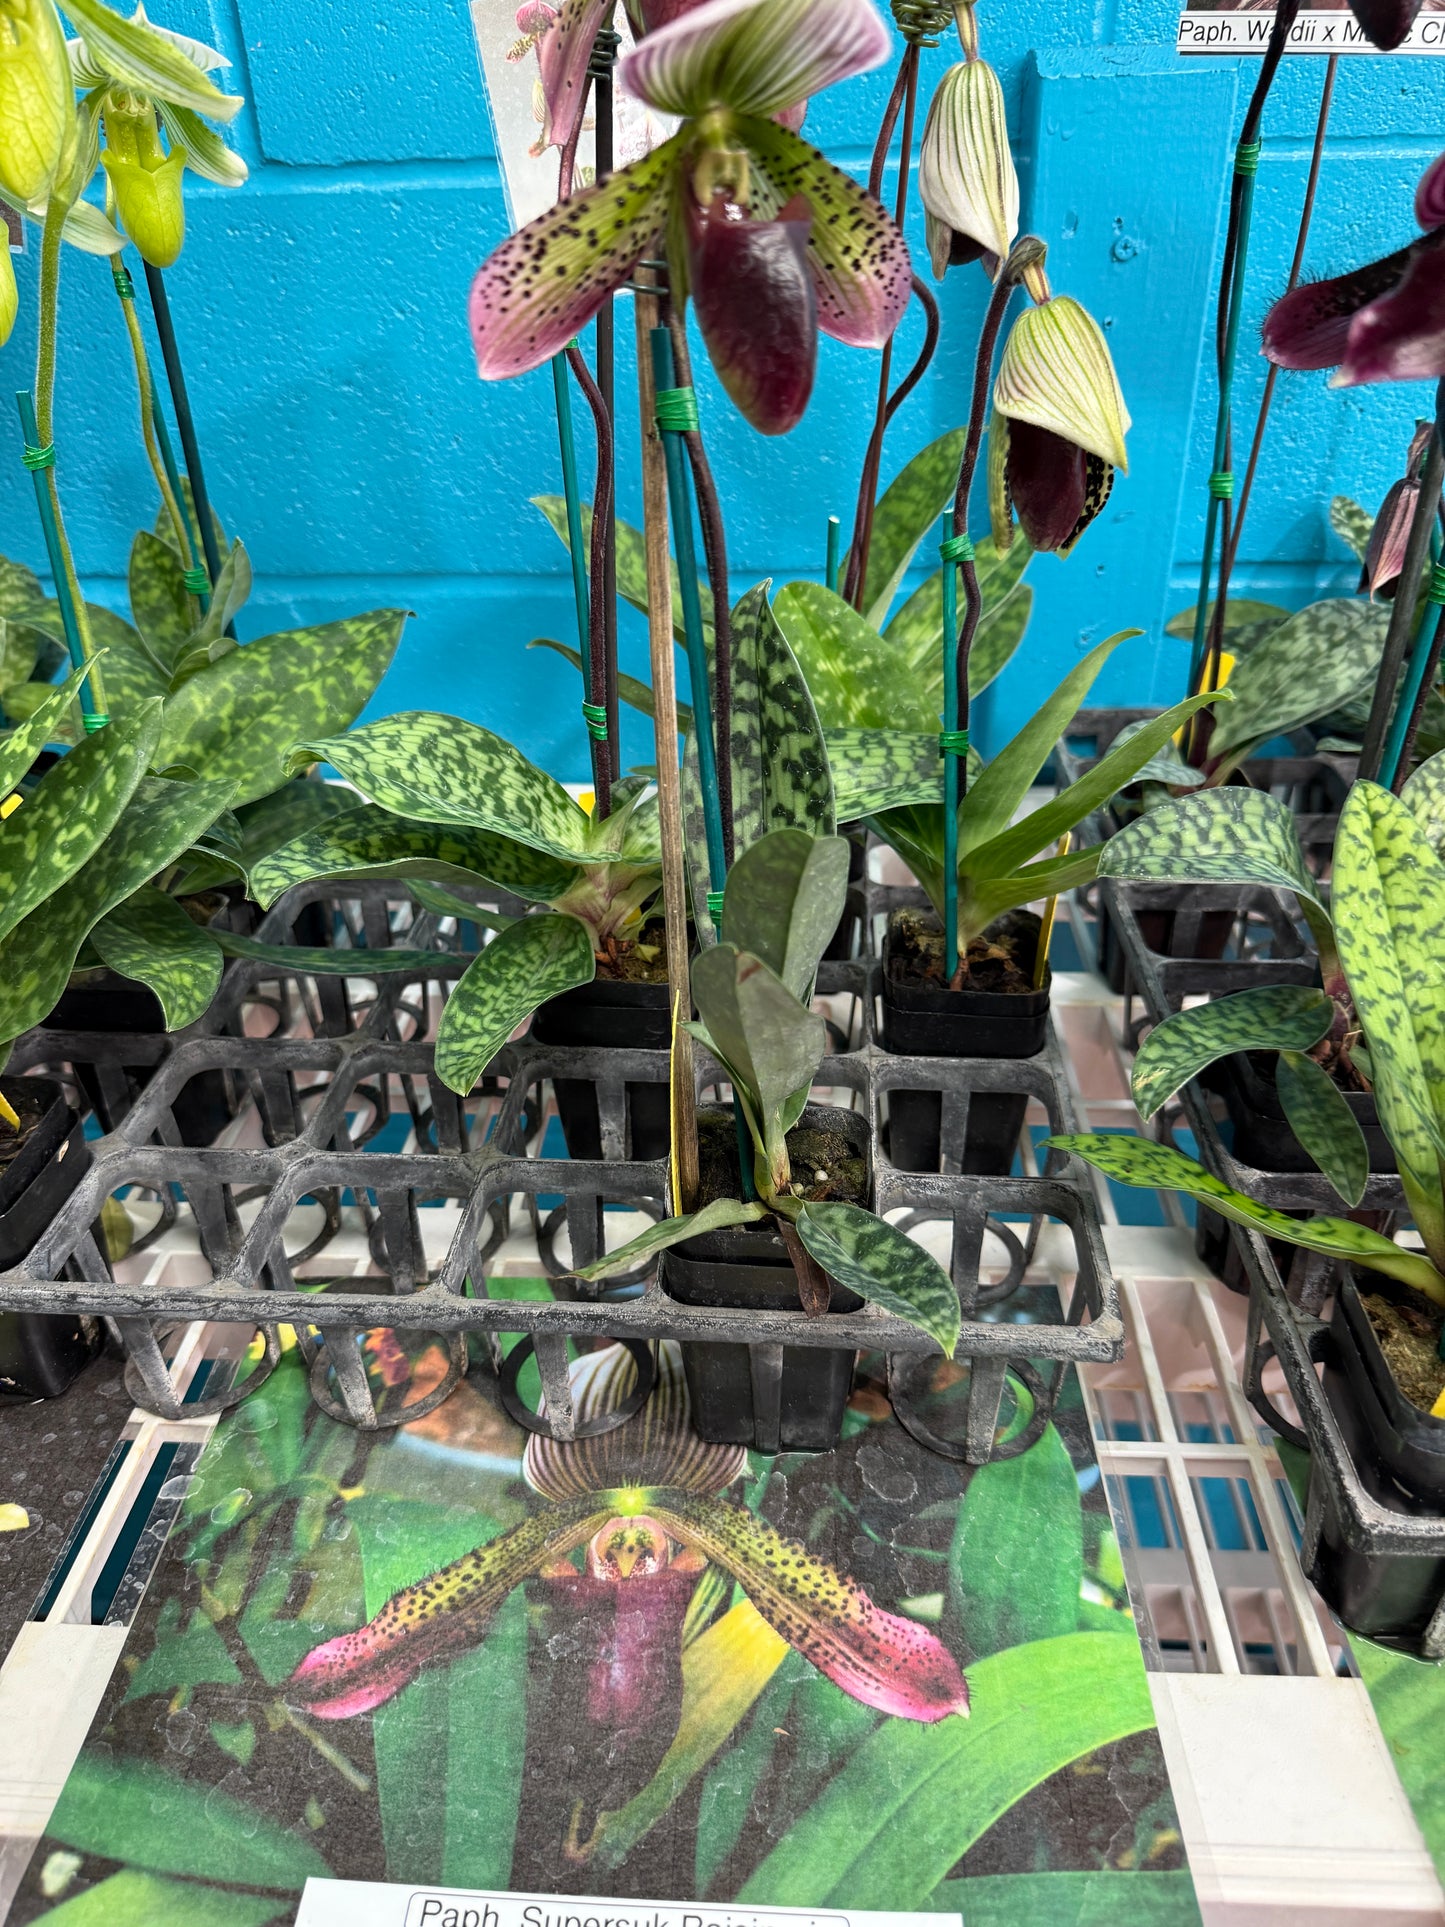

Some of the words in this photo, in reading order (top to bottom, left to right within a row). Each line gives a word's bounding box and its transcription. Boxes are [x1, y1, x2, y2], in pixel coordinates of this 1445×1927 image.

[1178, 19, 1238, 45] Paph.
[1247, 19, 1317, 42] Wdii
[1321, 25, 1337, 42] x
[1421, 21, 1445, 44] C
